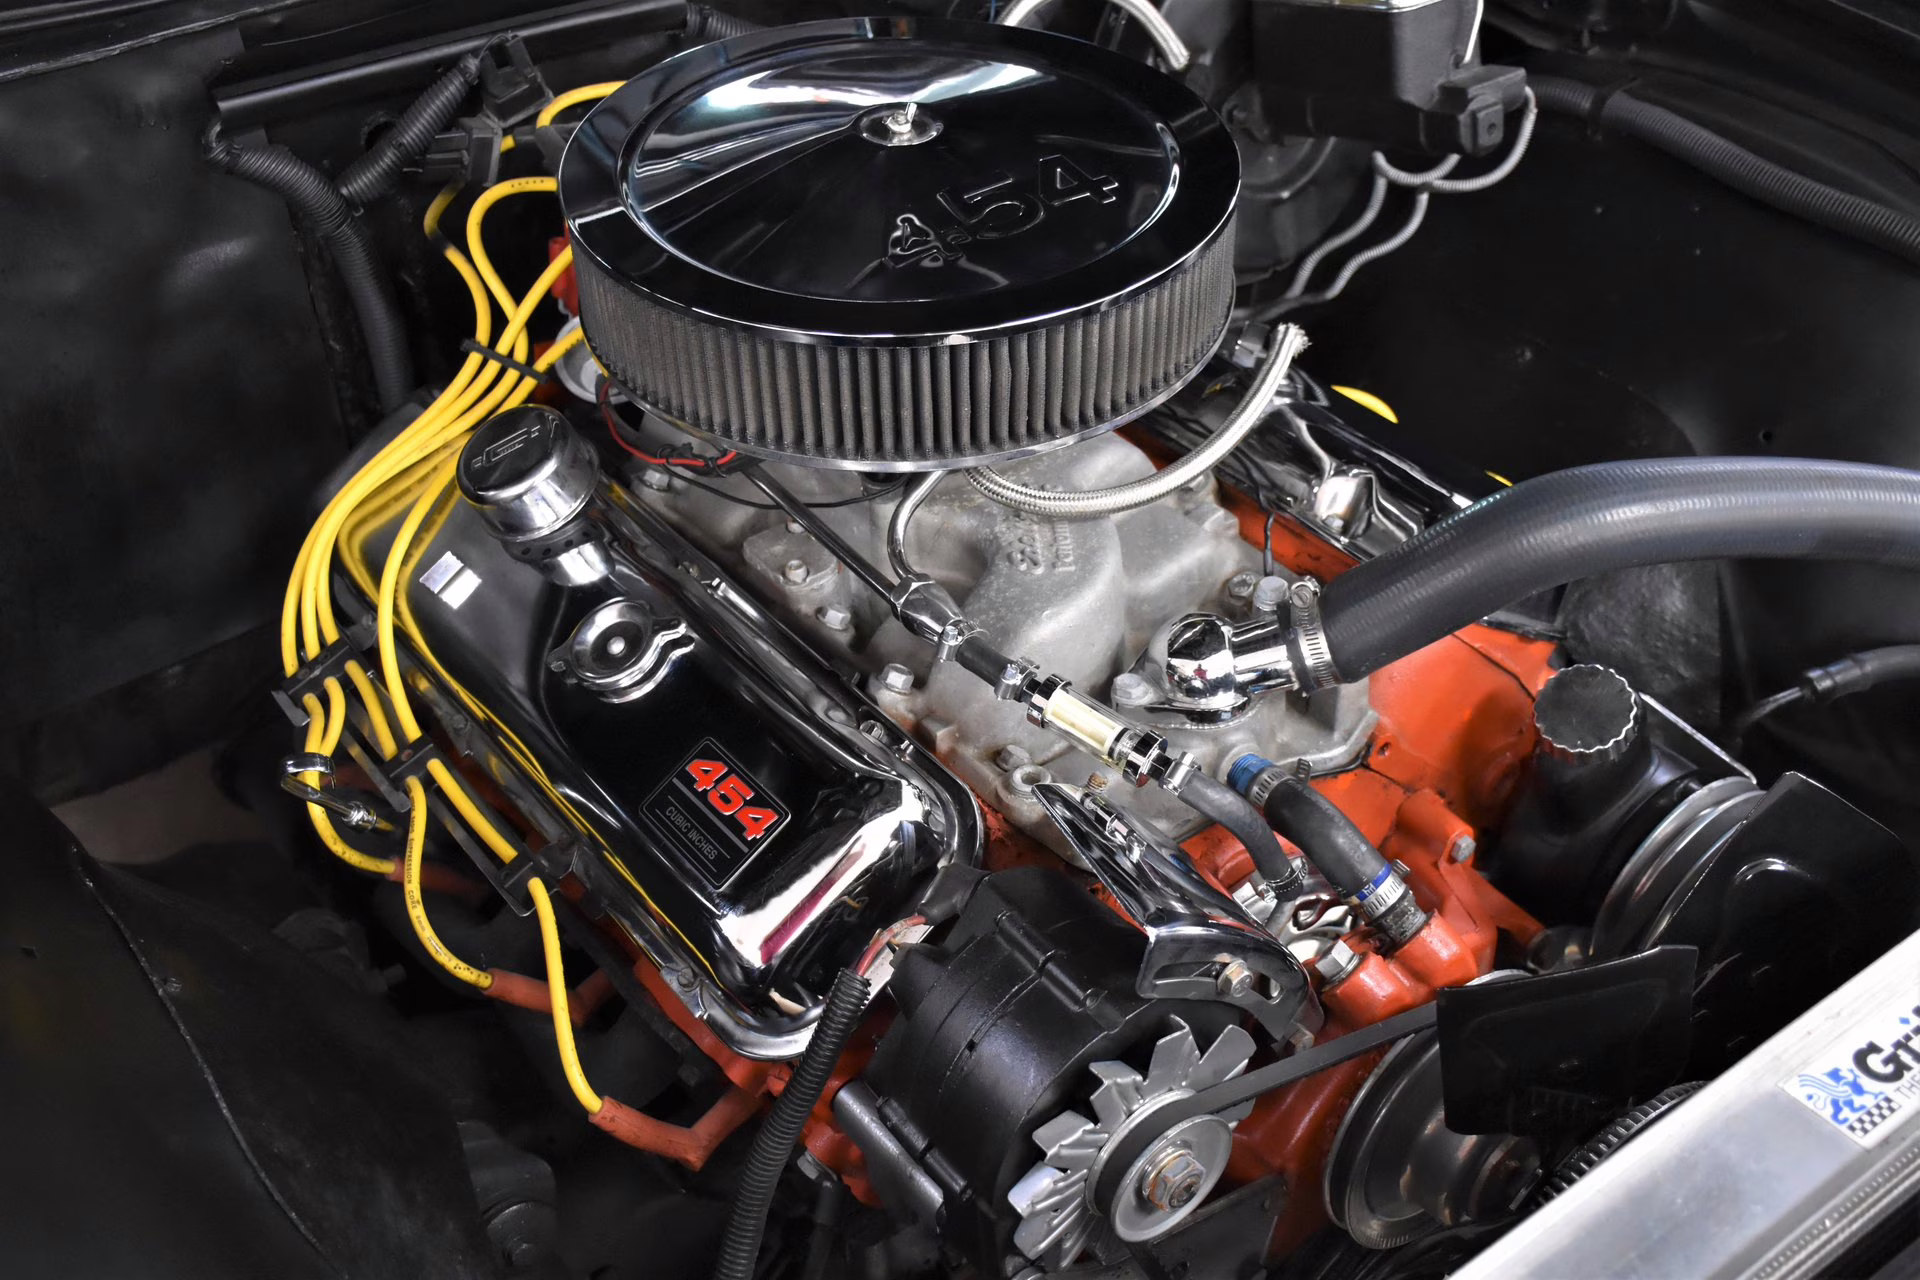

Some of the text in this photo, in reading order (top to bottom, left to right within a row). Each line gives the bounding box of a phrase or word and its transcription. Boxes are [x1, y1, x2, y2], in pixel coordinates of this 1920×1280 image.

[665, 806, 718, 860] CUBIC INCHES
[685, 758, 780, 841] 454
[1852, 1005, 1920, 1084] Gr
